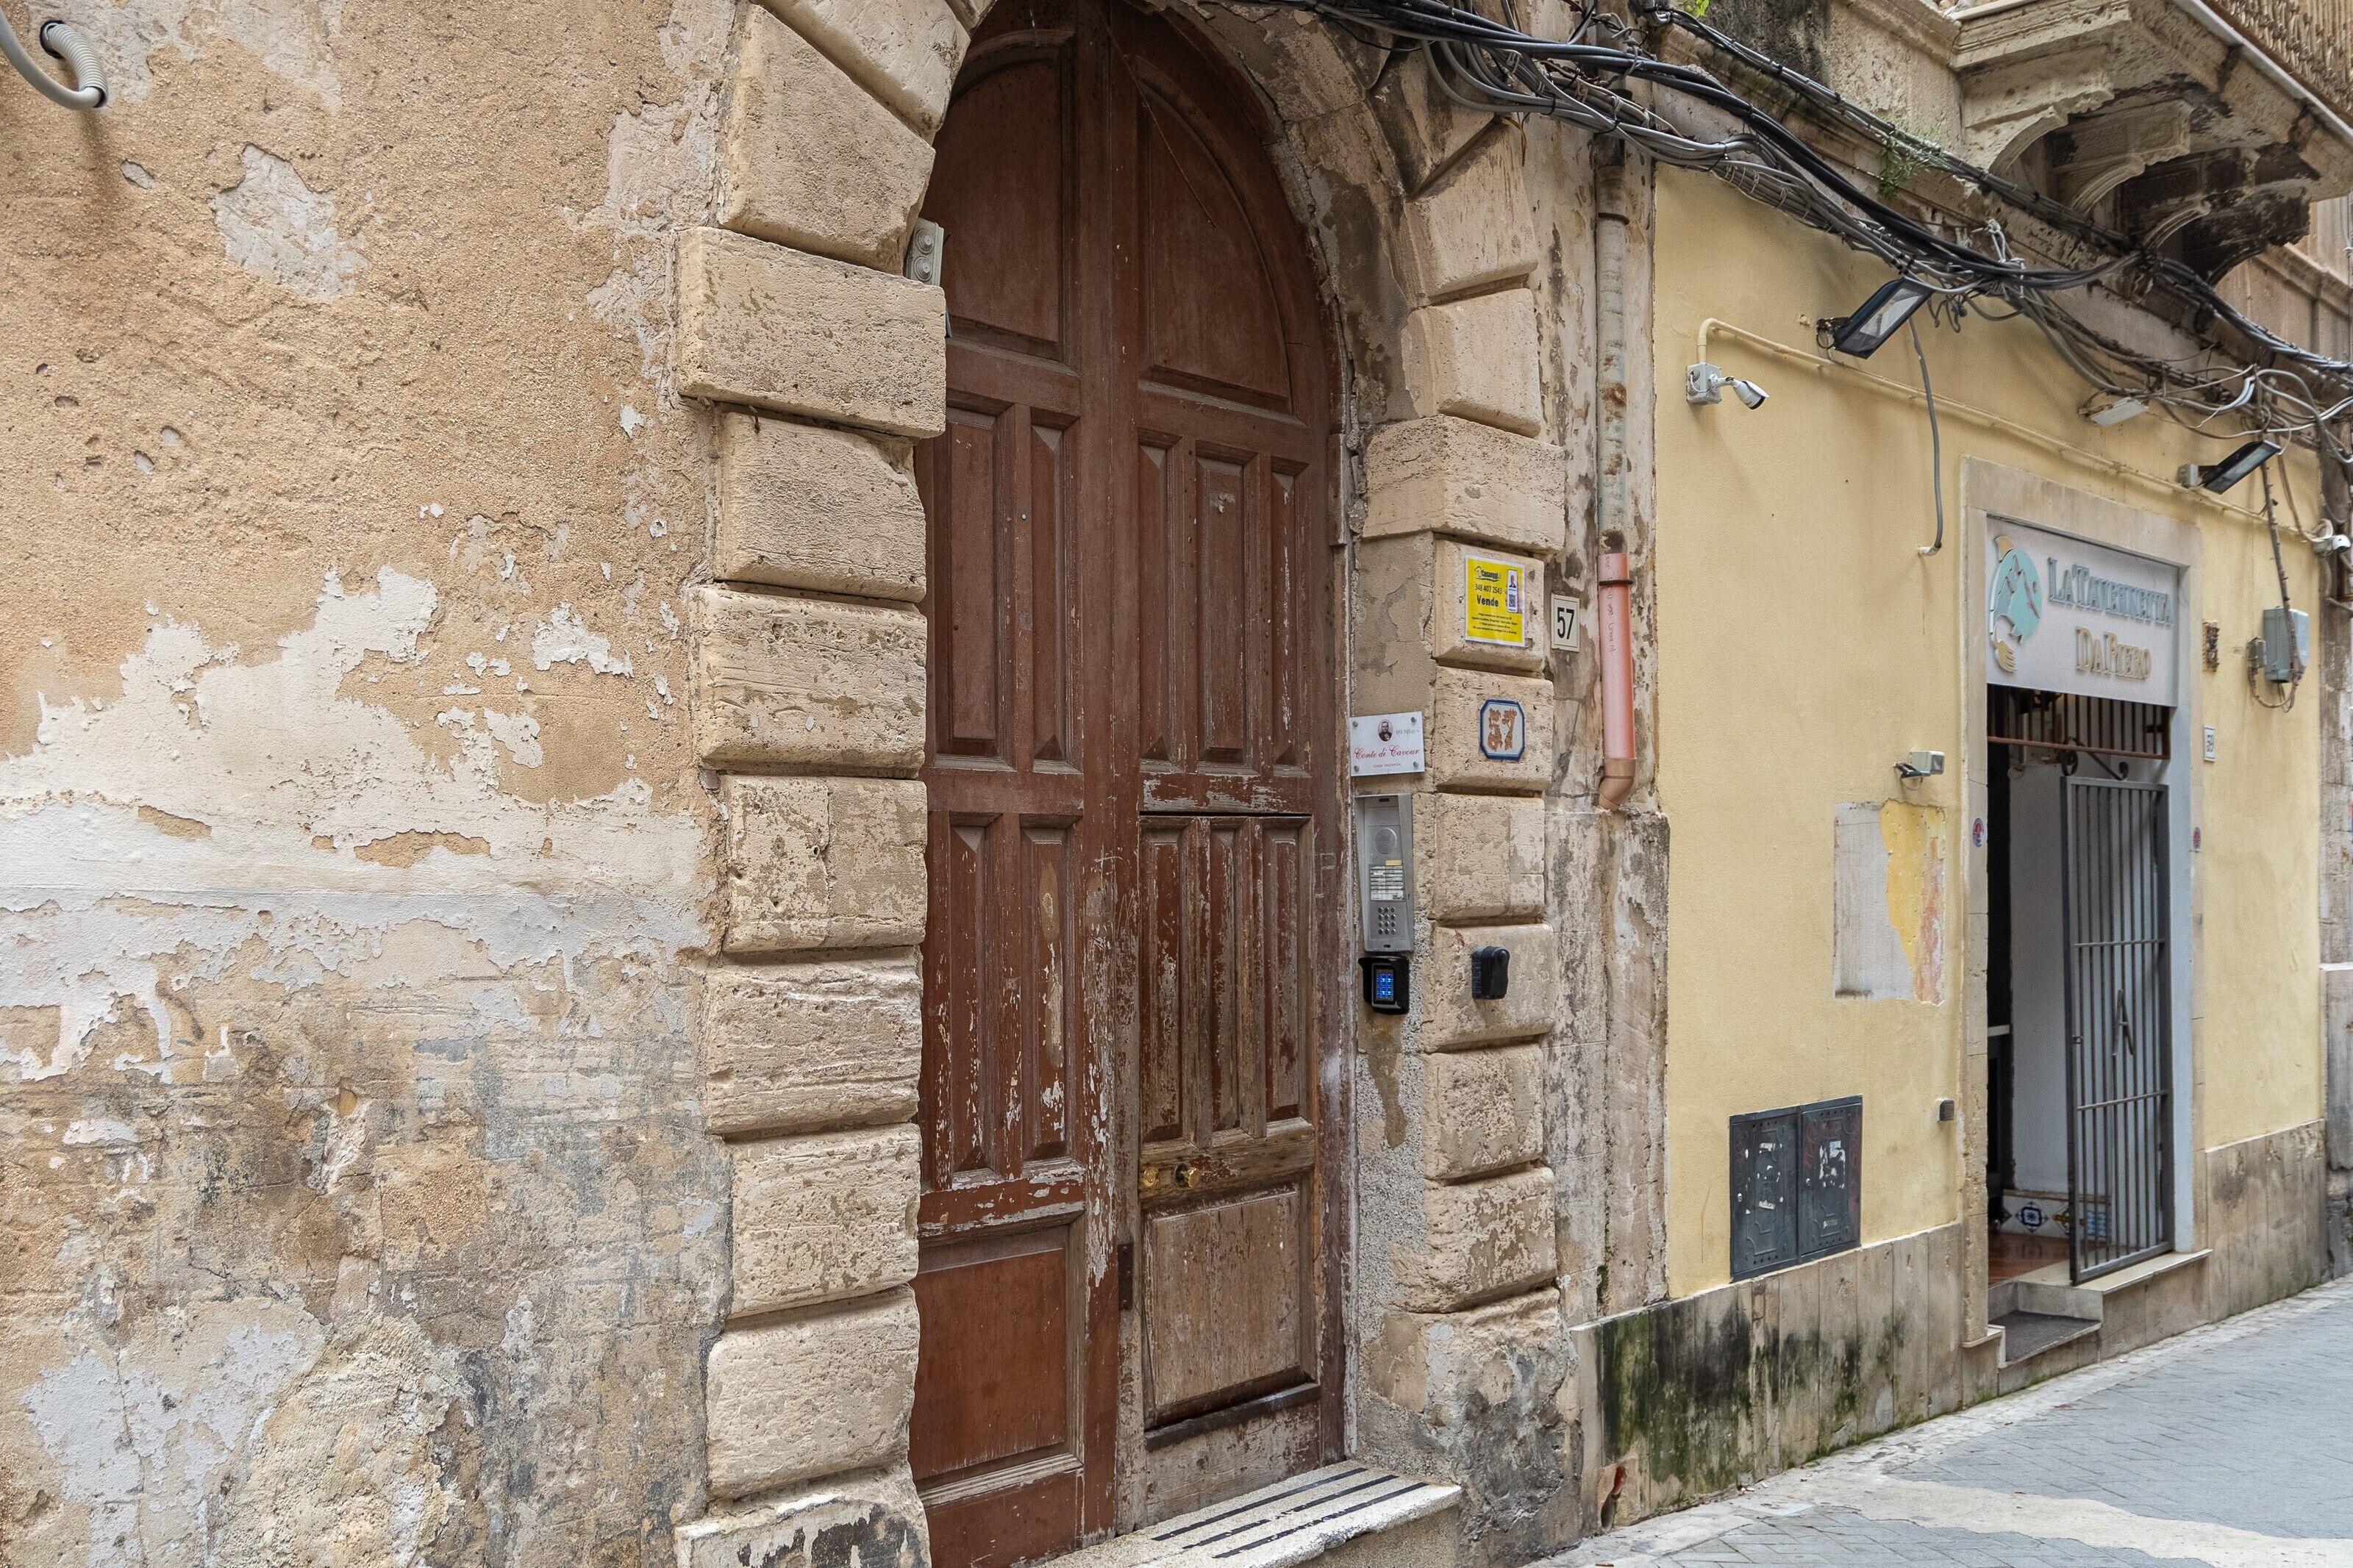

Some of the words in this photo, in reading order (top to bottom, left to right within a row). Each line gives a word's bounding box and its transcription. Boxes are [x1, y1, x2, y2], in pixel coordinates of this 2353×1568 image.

[1477, 594, 1499, 607] Vende
[1557, 606, 1574, 640] 57
[1354, 747, 1377, 759] Conte
[1378, 748, 1387, 758] di
[1389, 745, 1420, 757] Cavour
